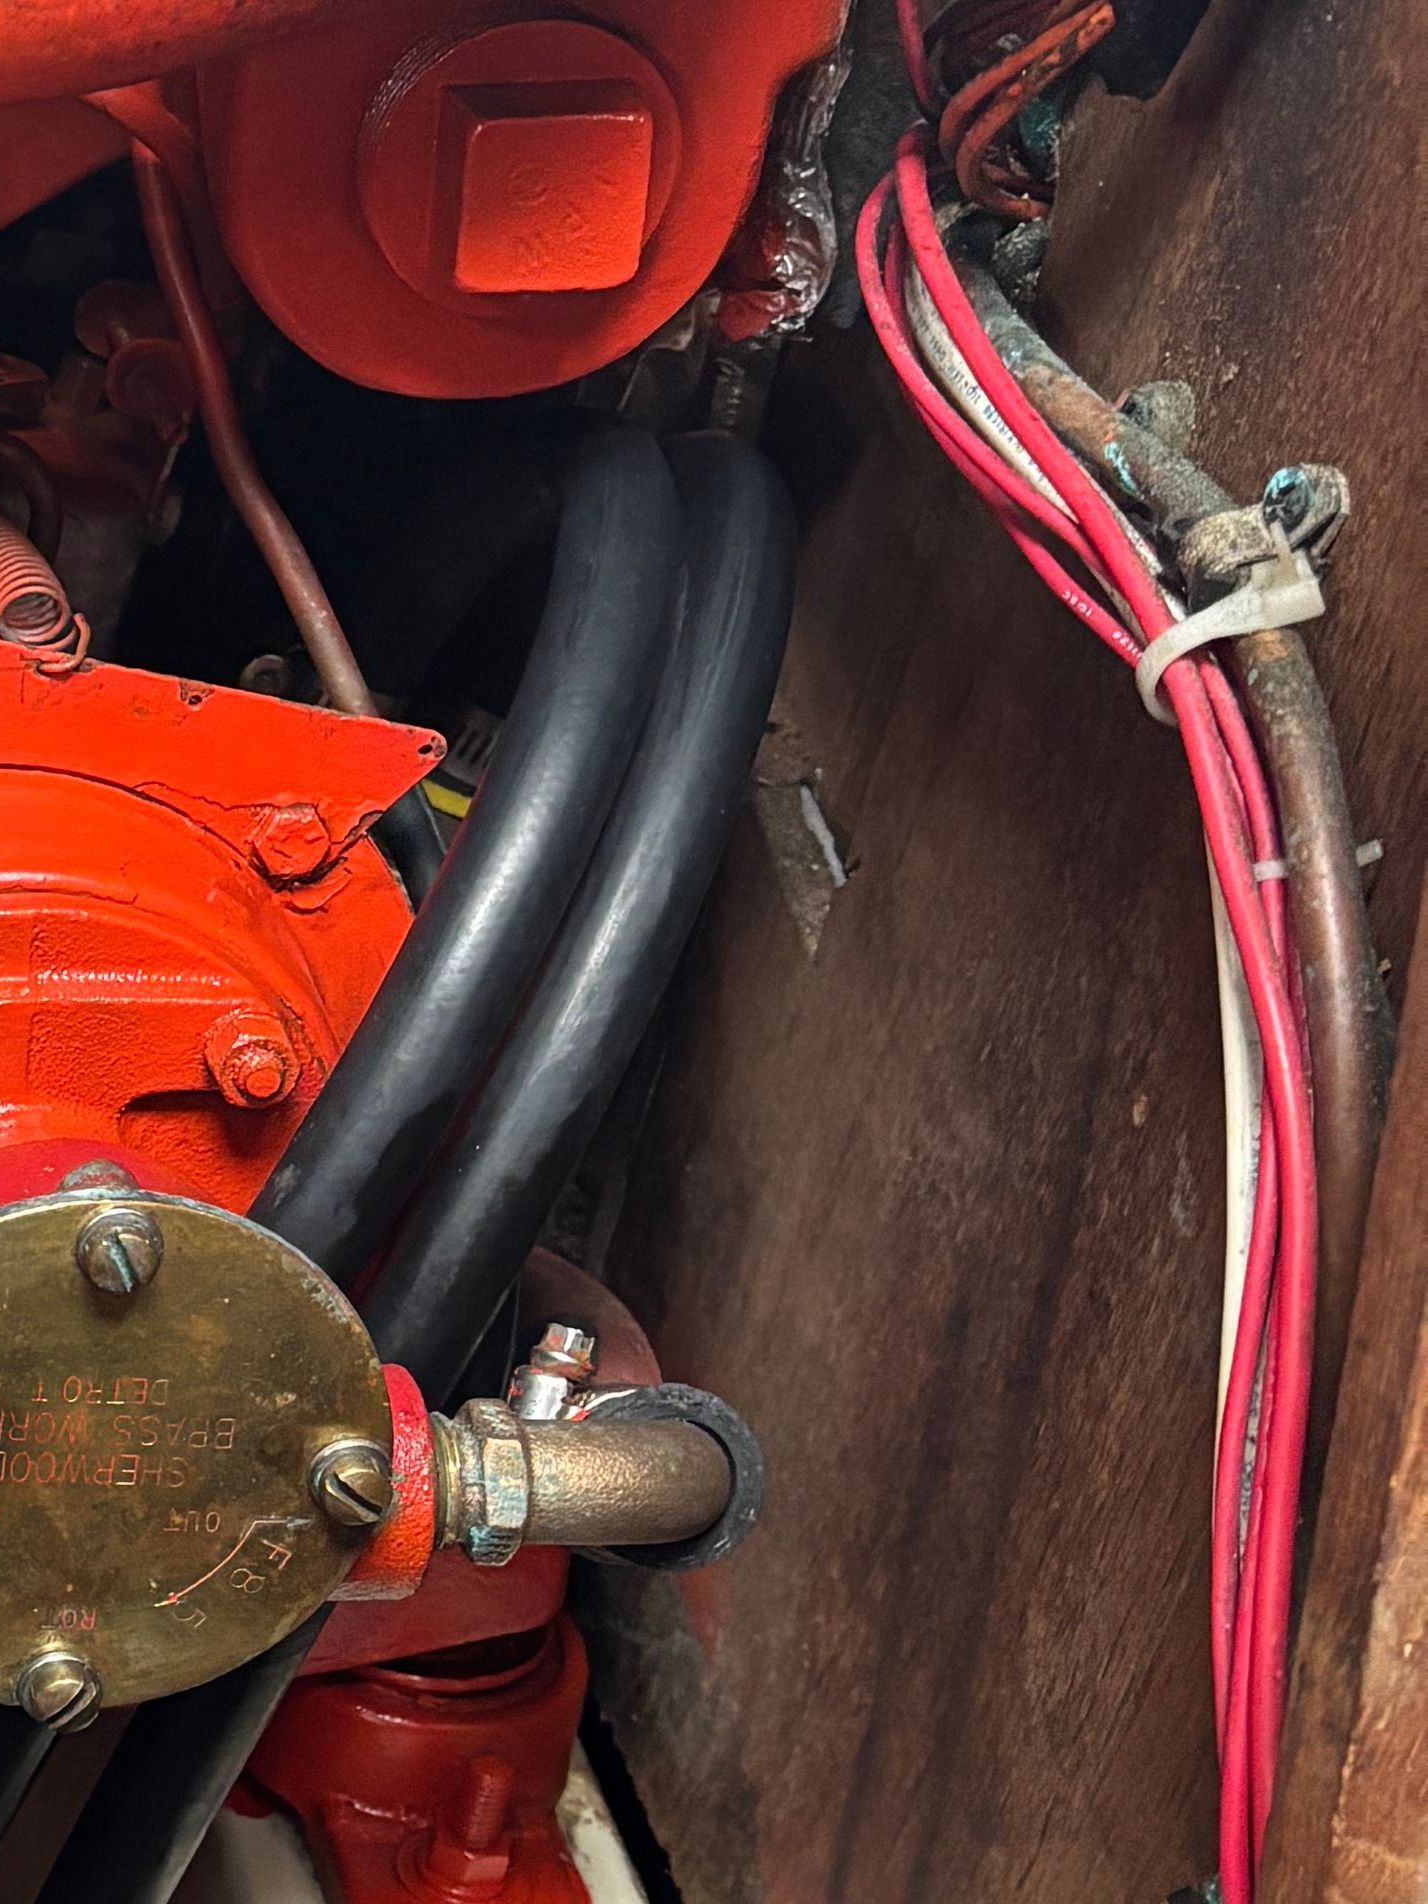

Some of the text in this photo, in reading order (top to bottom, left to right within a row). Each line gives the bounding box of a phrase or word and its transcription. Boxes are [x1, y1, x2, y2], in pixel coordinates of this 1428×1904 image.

[30, 1377, 169, 1405] DETROT
[112, 1416, 236, 1451] BRASS
[163, 1510, 221, 1534] OUT
